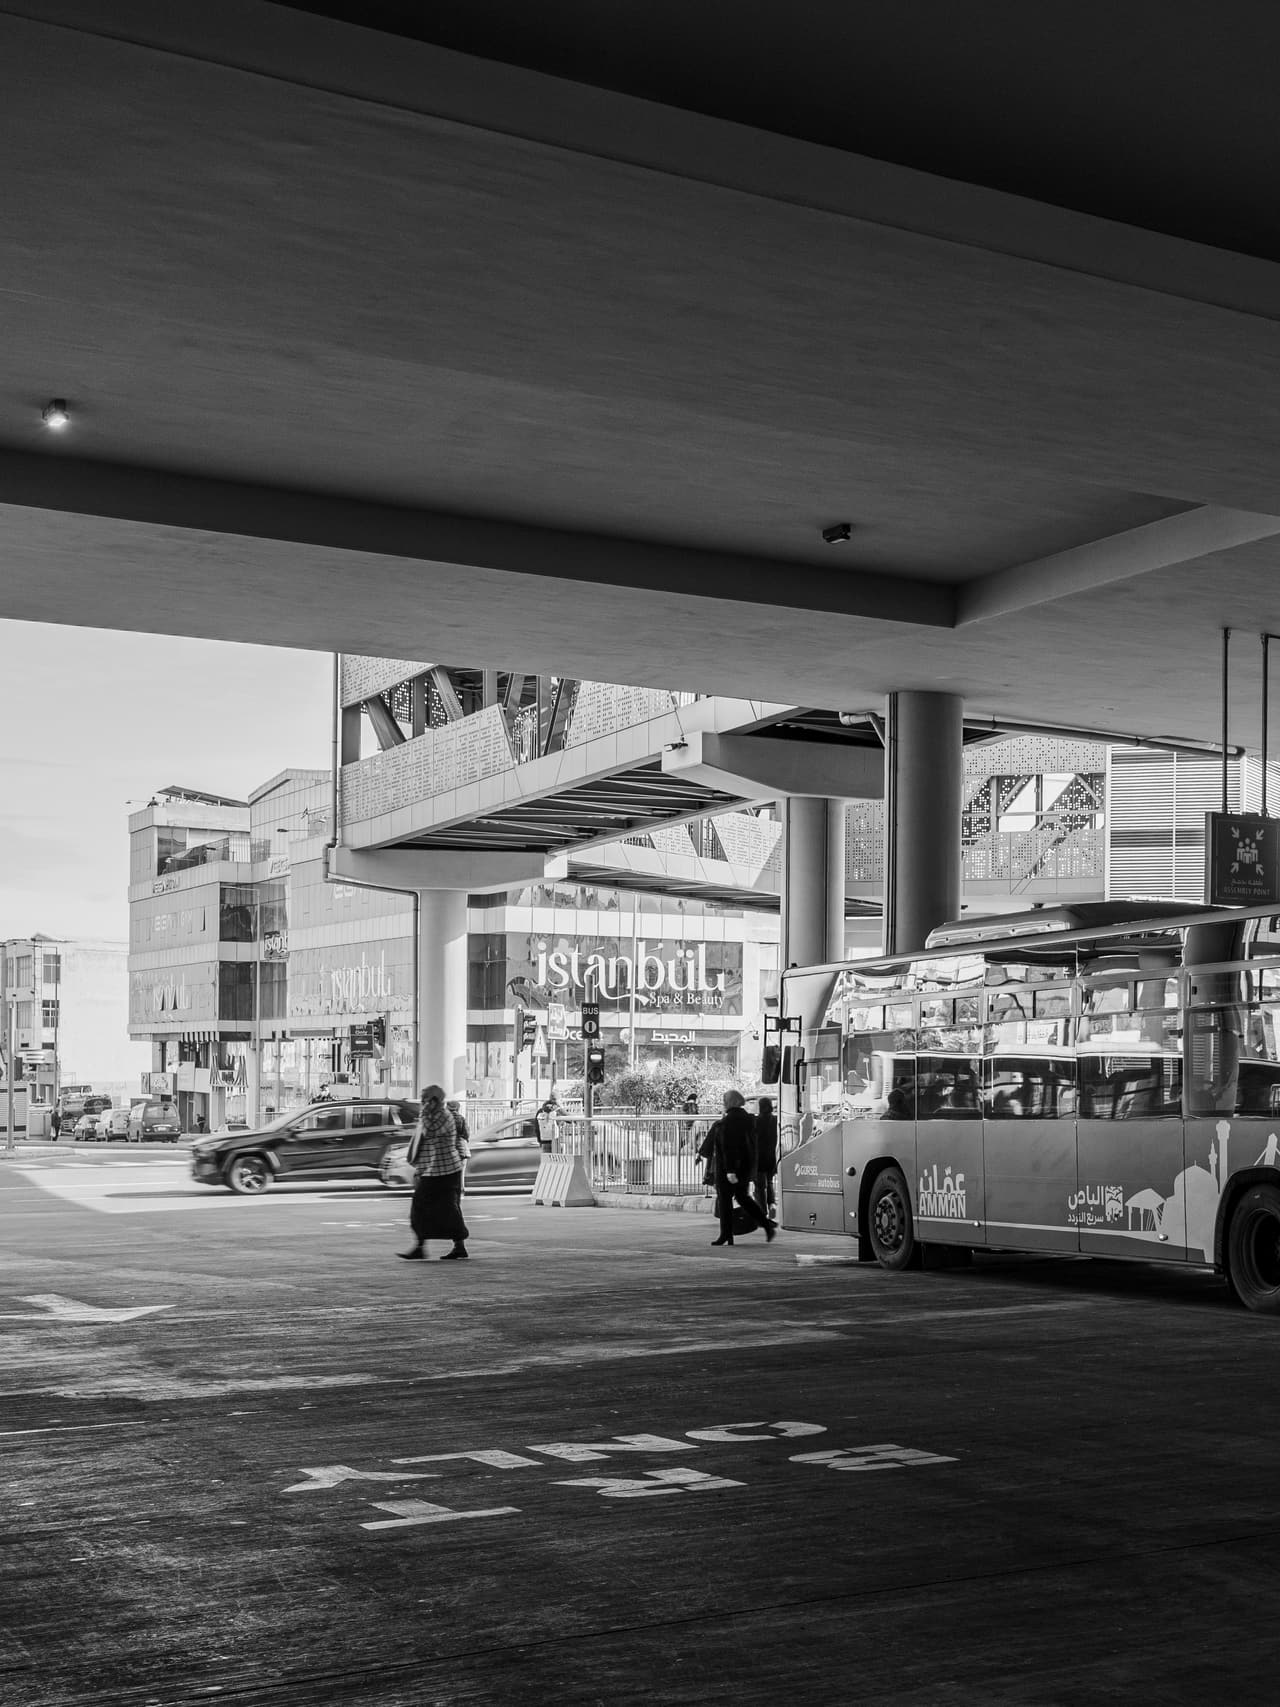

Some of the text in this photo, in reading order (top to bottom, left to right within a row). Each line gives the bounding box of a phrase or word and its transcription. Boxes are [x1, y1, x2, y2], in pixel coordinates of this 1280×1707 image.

[1253, 887, 1270, 896] POINT
[650, 991, 723, 1009] Spa & Beauty
[582, 1007, 599, 1015] BUS
[651, 1030, 696, 1044] المحيط
[919, 1192, 967, 1218] AMMAN
[1068, 1185, 1104, 1211] الباص
[1067, 1212, 1104, 1226] سريع التردد
[279, 1421, 828, 1493] ONLY
